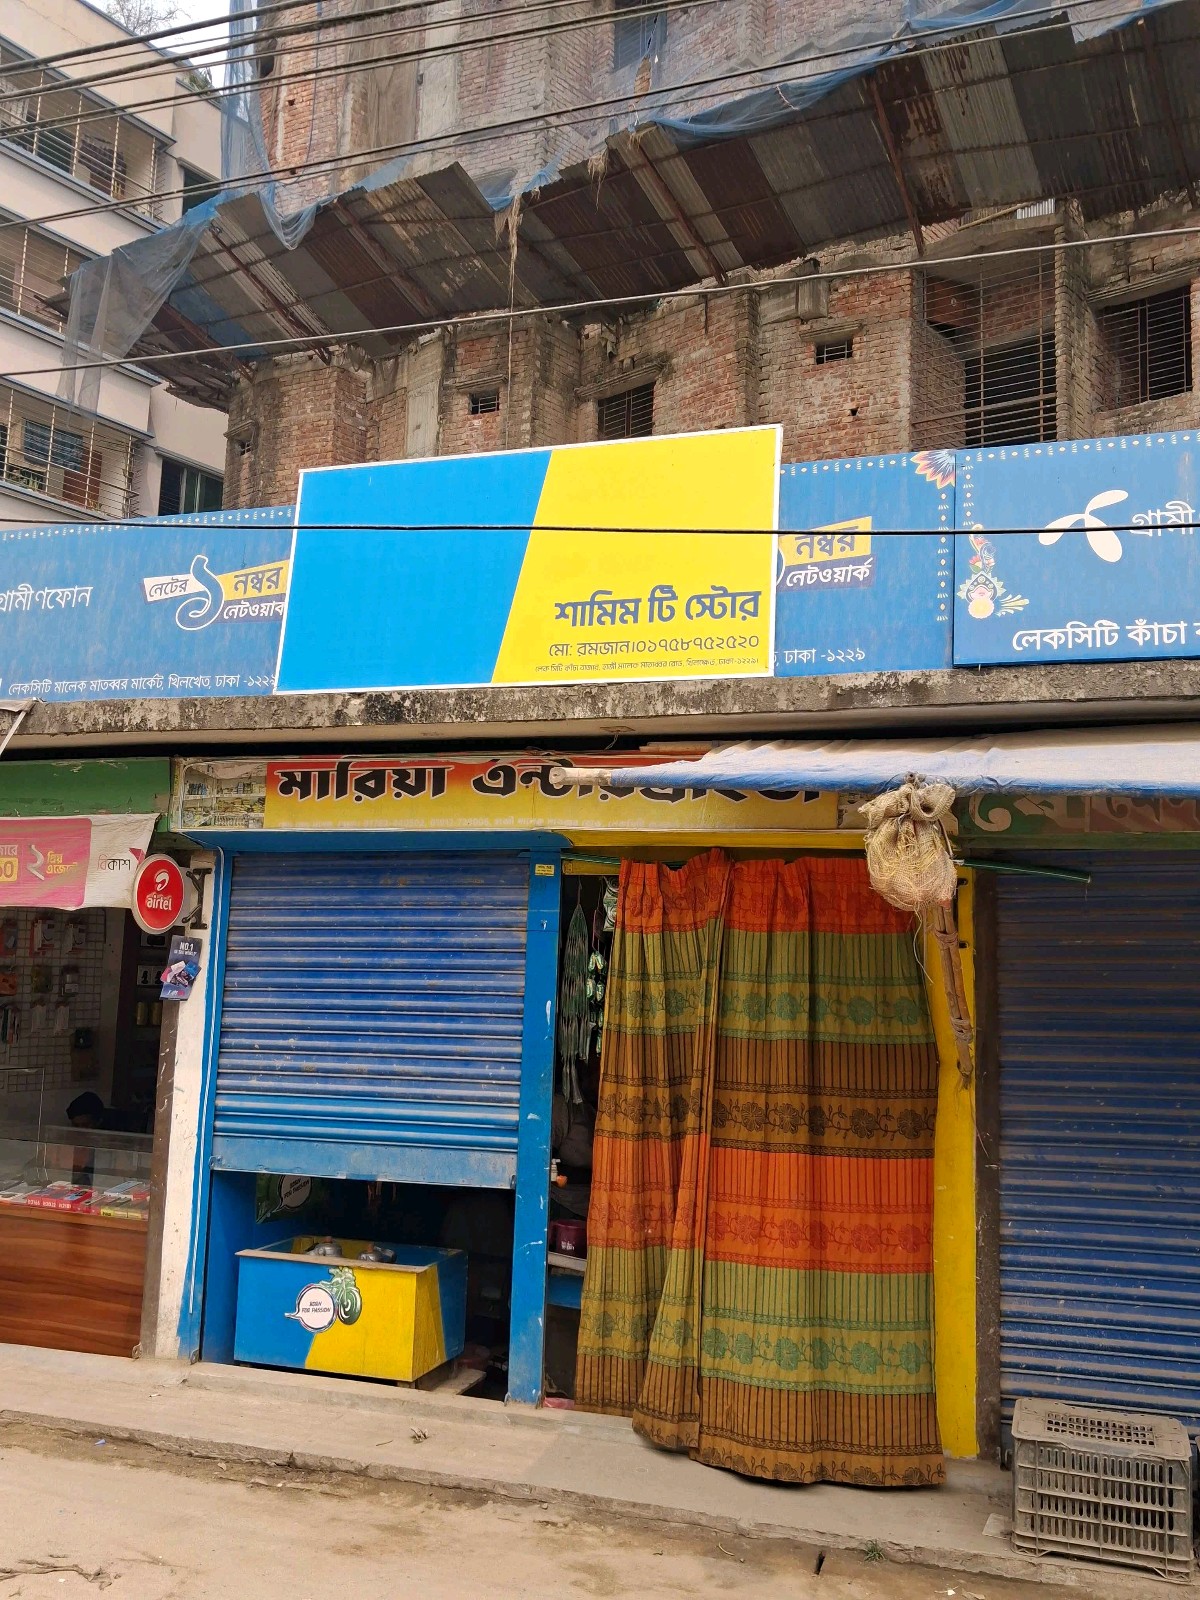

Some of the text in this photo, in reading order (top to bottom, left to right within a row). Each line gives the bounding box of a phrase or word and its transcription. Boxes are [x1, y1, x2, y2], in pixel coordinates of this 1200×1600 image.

[794, 525, 859, 559] নম্বর
[233, 566, 284, 595] নম্বর
[785, 556, 874, 587] নেটওয়ার্ক
[148, 576, 190, 598] নেটের
[554, 584, 762, 627] শামিম টি স্টোর
[1012, 619, 1120, 651] লেকসিটি
[1125, 618, 1188, 647] কাঁচা
[784, 648, 816, 665] ঢাকা
[8, 679, 53, 696] লেকসিটি
[54, 680, 88, 694] মালেক
[89, 678, 129, 692] মাতব্বর
[168, 673, 212, 690] খিলখেত,
[215, 673, 241, 688] ঢাকা
[273, 754, 455, 802] মারিয়া
[97, 853, 131, 871] বিকাশ
[146, 893, 173, 911] airtel
